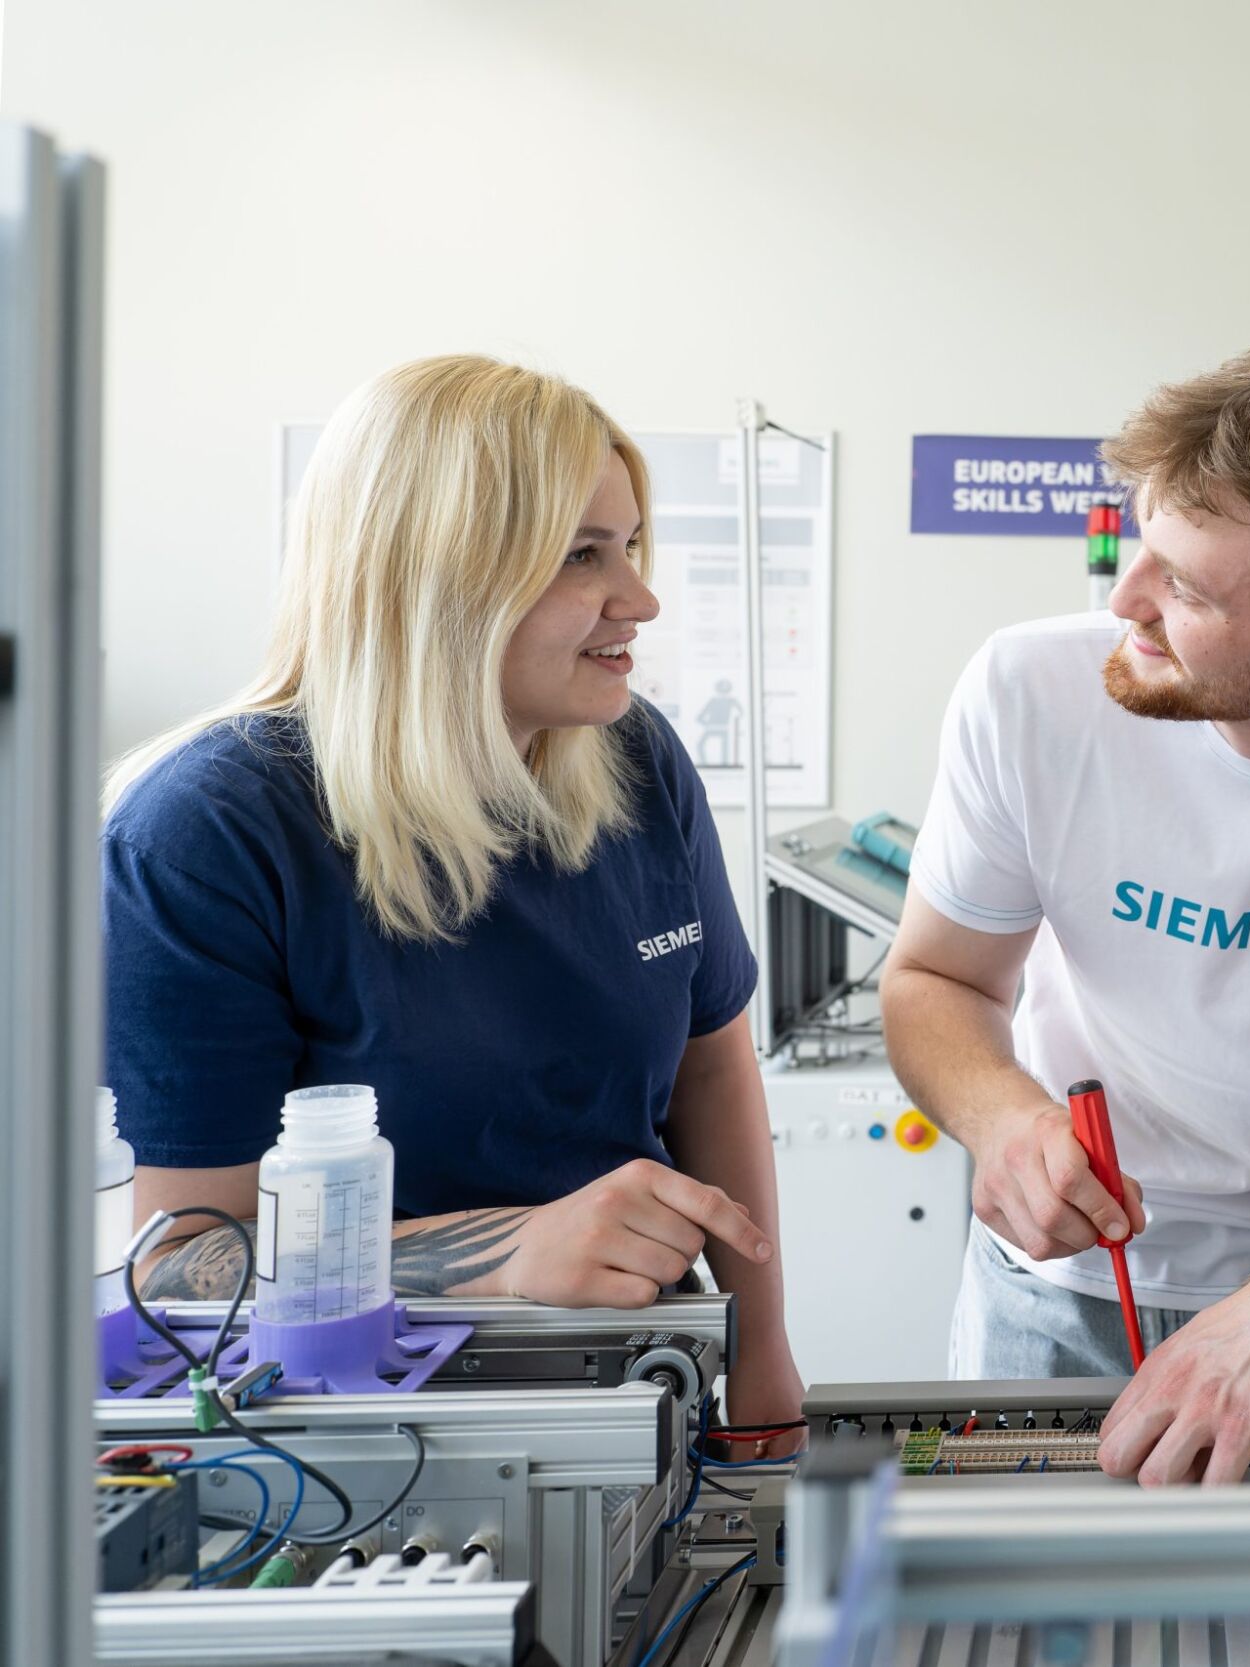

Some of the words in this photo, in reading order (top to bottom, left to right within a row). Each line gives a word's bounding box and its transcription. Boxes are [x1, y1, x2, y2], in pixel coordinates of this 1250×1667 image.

[953, 459, 1094, 485] EUROPEAN
[952, 488, 1043, 513] SKILLS
[406, 1506, 425, 1516] DO
